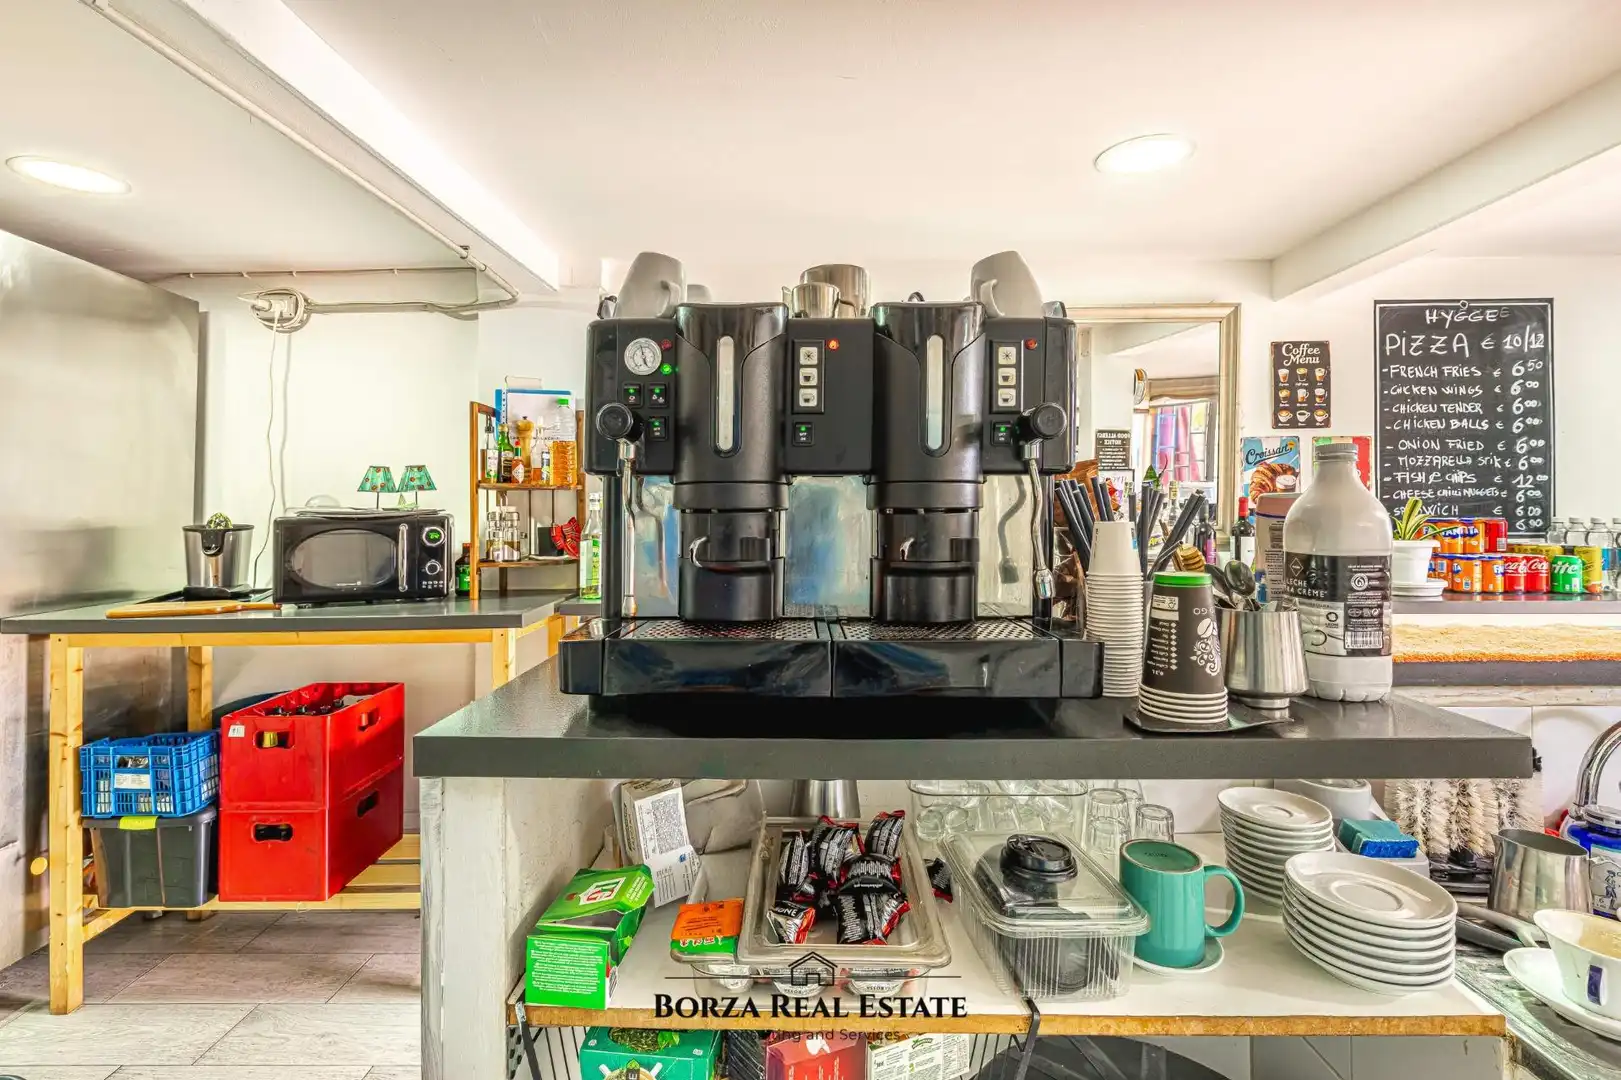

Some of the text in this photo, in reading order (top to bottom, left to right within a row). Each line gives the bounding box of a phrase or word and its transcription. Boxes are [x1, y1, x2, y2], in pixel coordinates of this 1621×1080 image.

[1282, 343, 1320, 356] Coffee
[1283, 353, 1320, 366] Menu
[1286, 578, 1308, 587] LECHE
